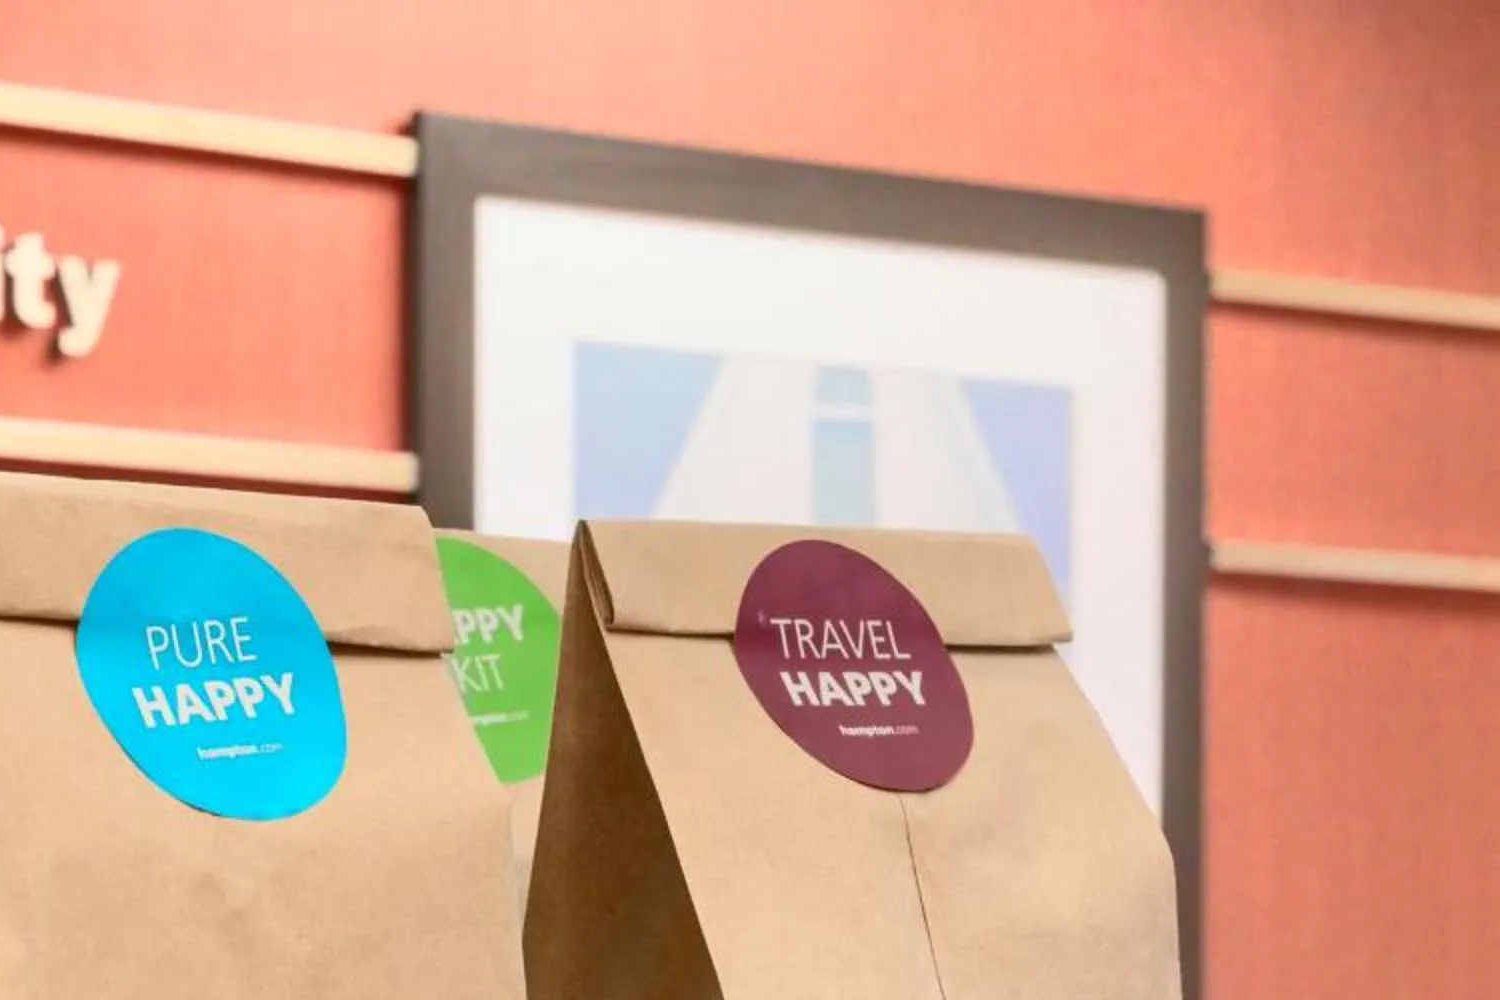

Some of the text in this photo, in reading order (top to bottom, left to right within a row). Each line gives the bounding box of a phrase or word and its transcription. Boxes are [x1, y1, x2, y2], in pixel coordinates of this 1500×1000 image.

[146, 616, 257, 671] PURE
[452, 603, 523, 644] PPY
[769, 617, 912, 660] TRAVEL
[131, 672, 296, 729] HAPPY
[779, 671, 926, 706] HAPPY
